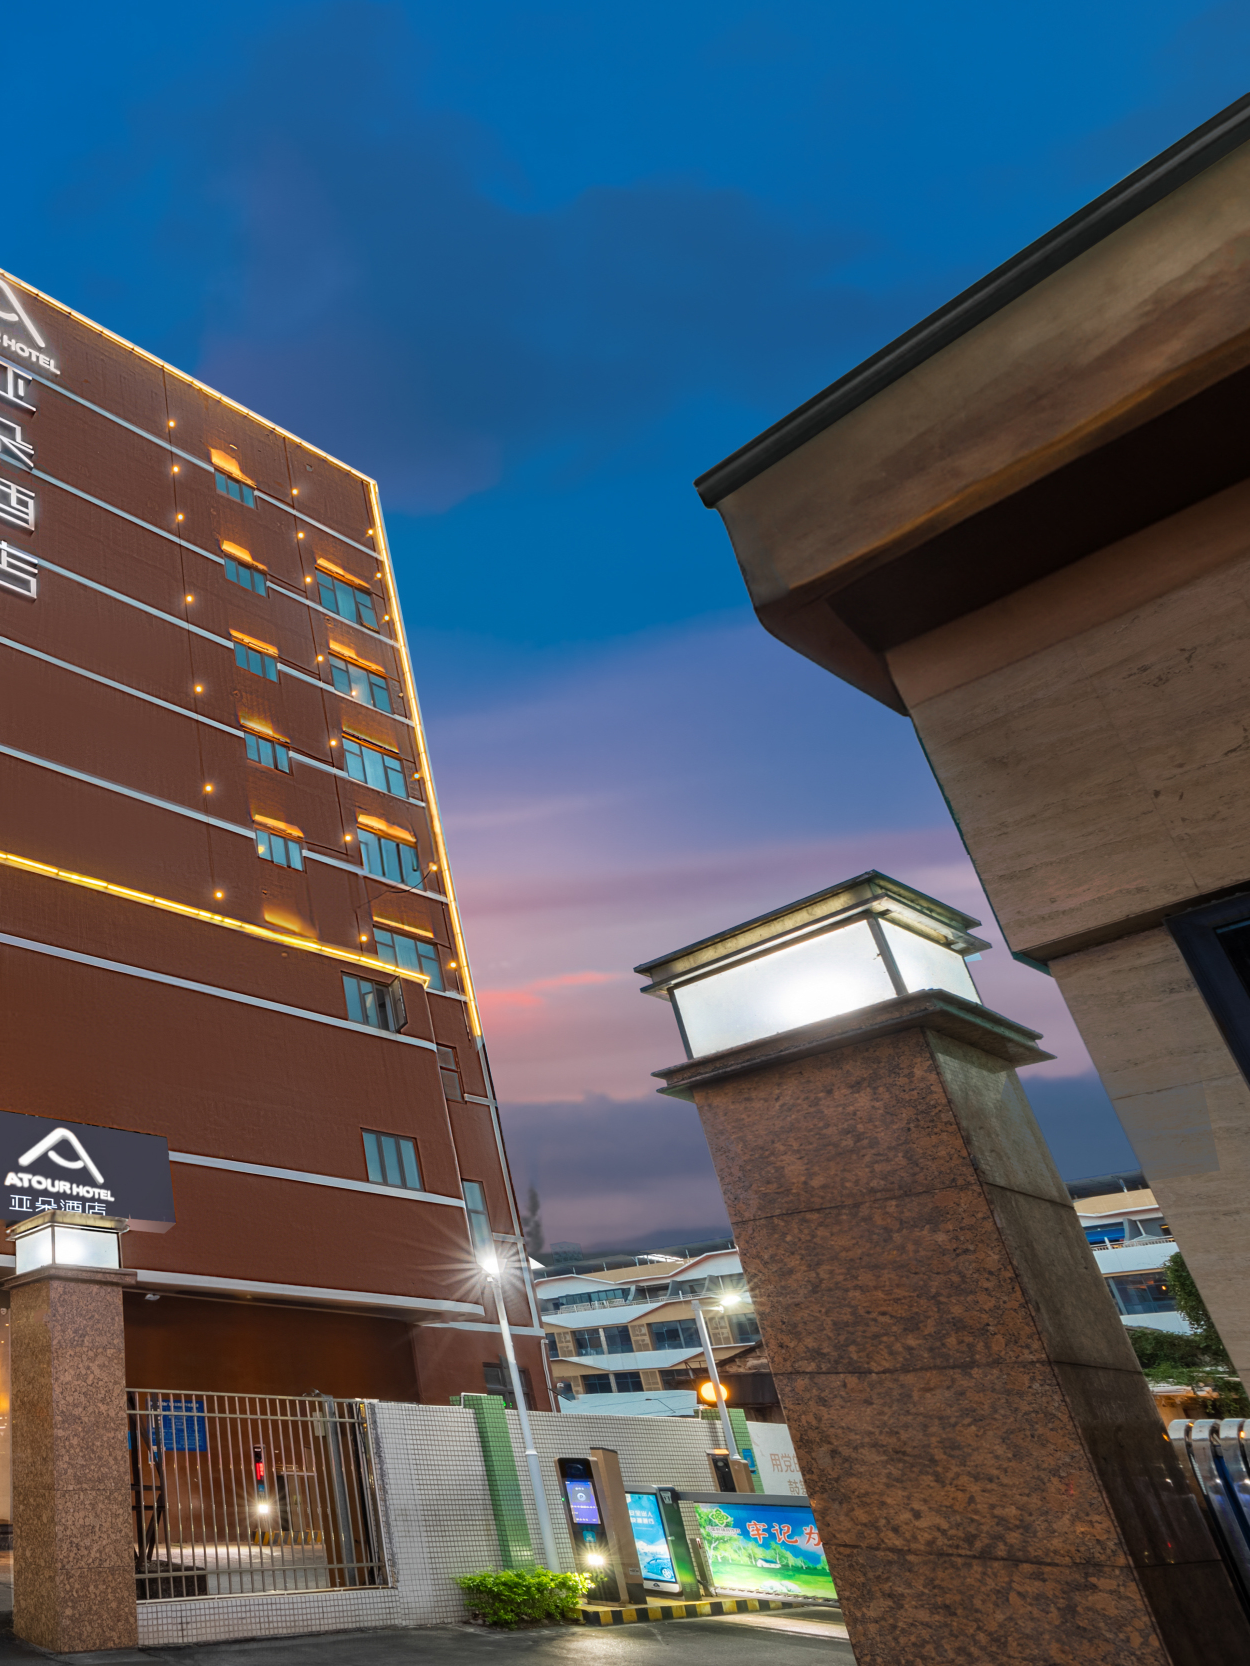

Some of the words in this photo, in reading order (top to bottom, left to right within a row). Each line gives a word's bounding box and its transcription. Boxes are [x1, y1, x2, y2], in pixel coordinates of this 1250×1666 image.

[2, 331, 61, 376] HOTEL
[4, 1171, 72, 1195] ATOUR
[72, 1182, 115, 1202] HOTEL
[746, 1520, 823, 1547] 牢记为
